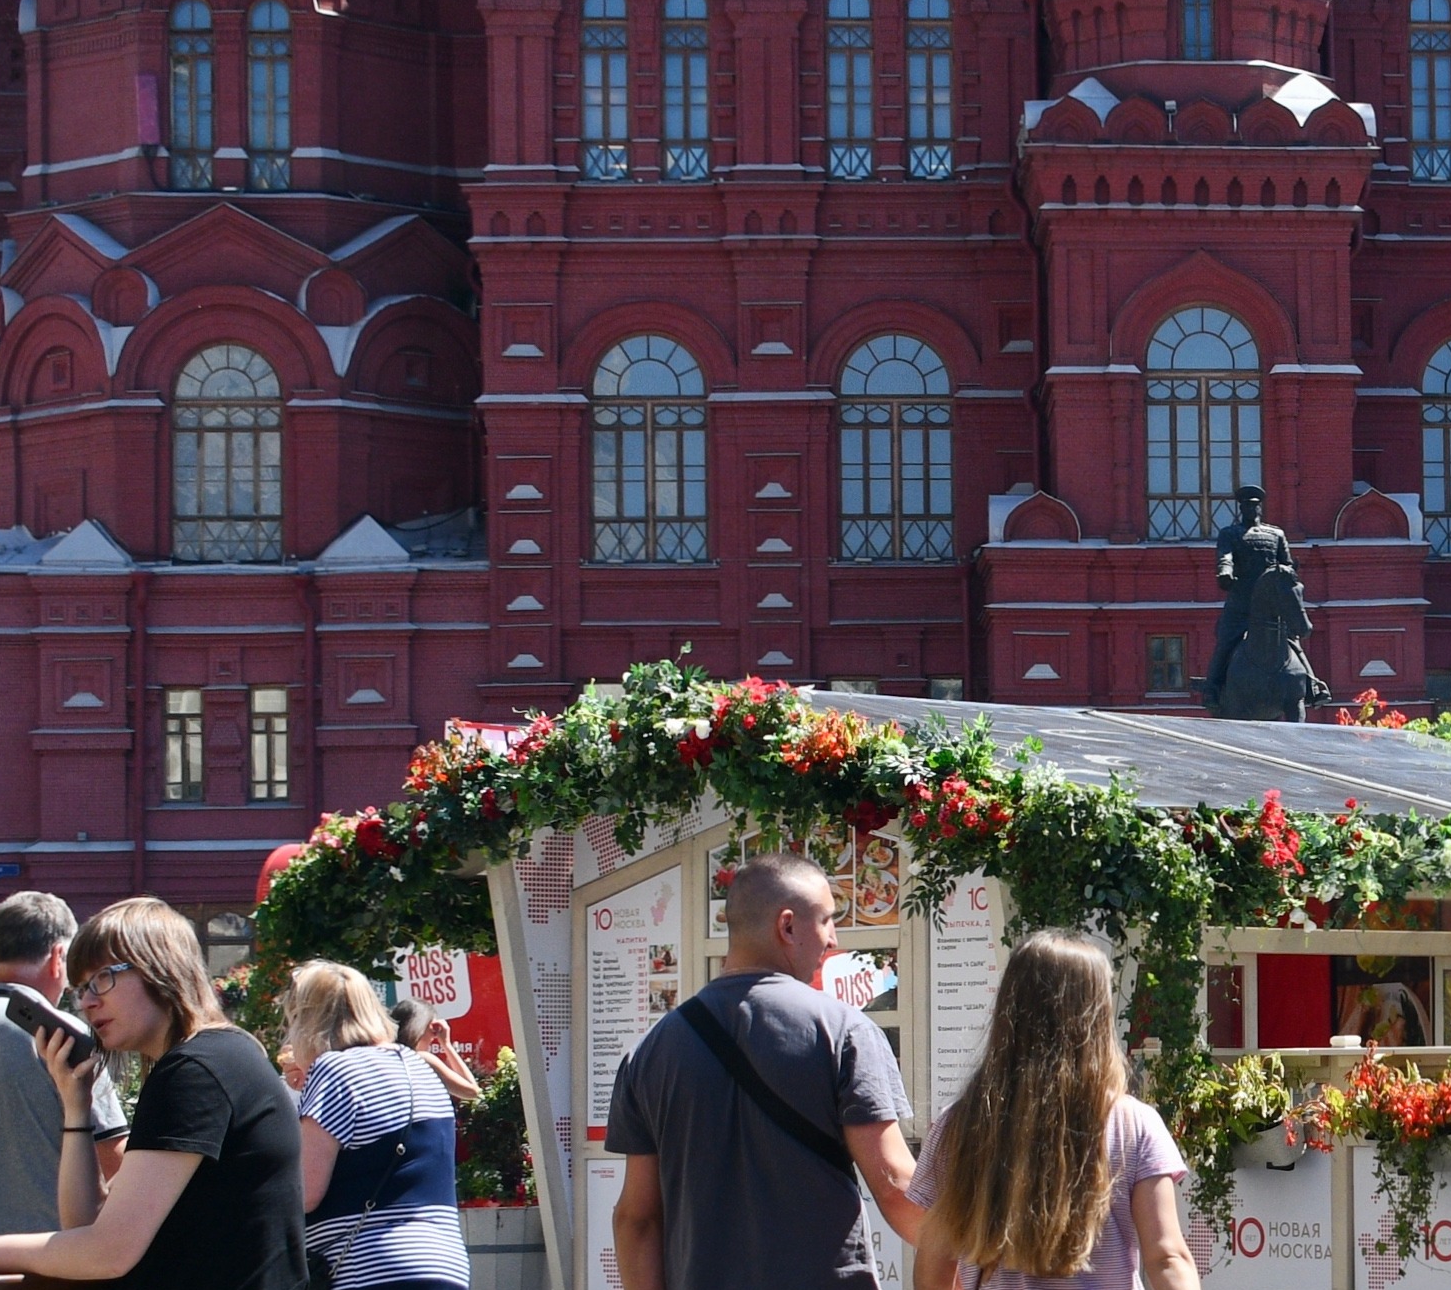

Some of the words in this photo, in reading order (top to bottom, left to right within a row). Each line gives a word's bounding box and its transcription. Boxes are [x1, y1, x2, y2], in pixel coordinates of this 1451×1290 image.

[593, 908, 613, 930] 10
[408, 950, 452, 980] RUSS
[1230, 1217, 1265, 1258] 10
[1269, 1222, 1320, 1238] НОВАЯ
[1269, 1244, 1331, 1259] МОСКВА
